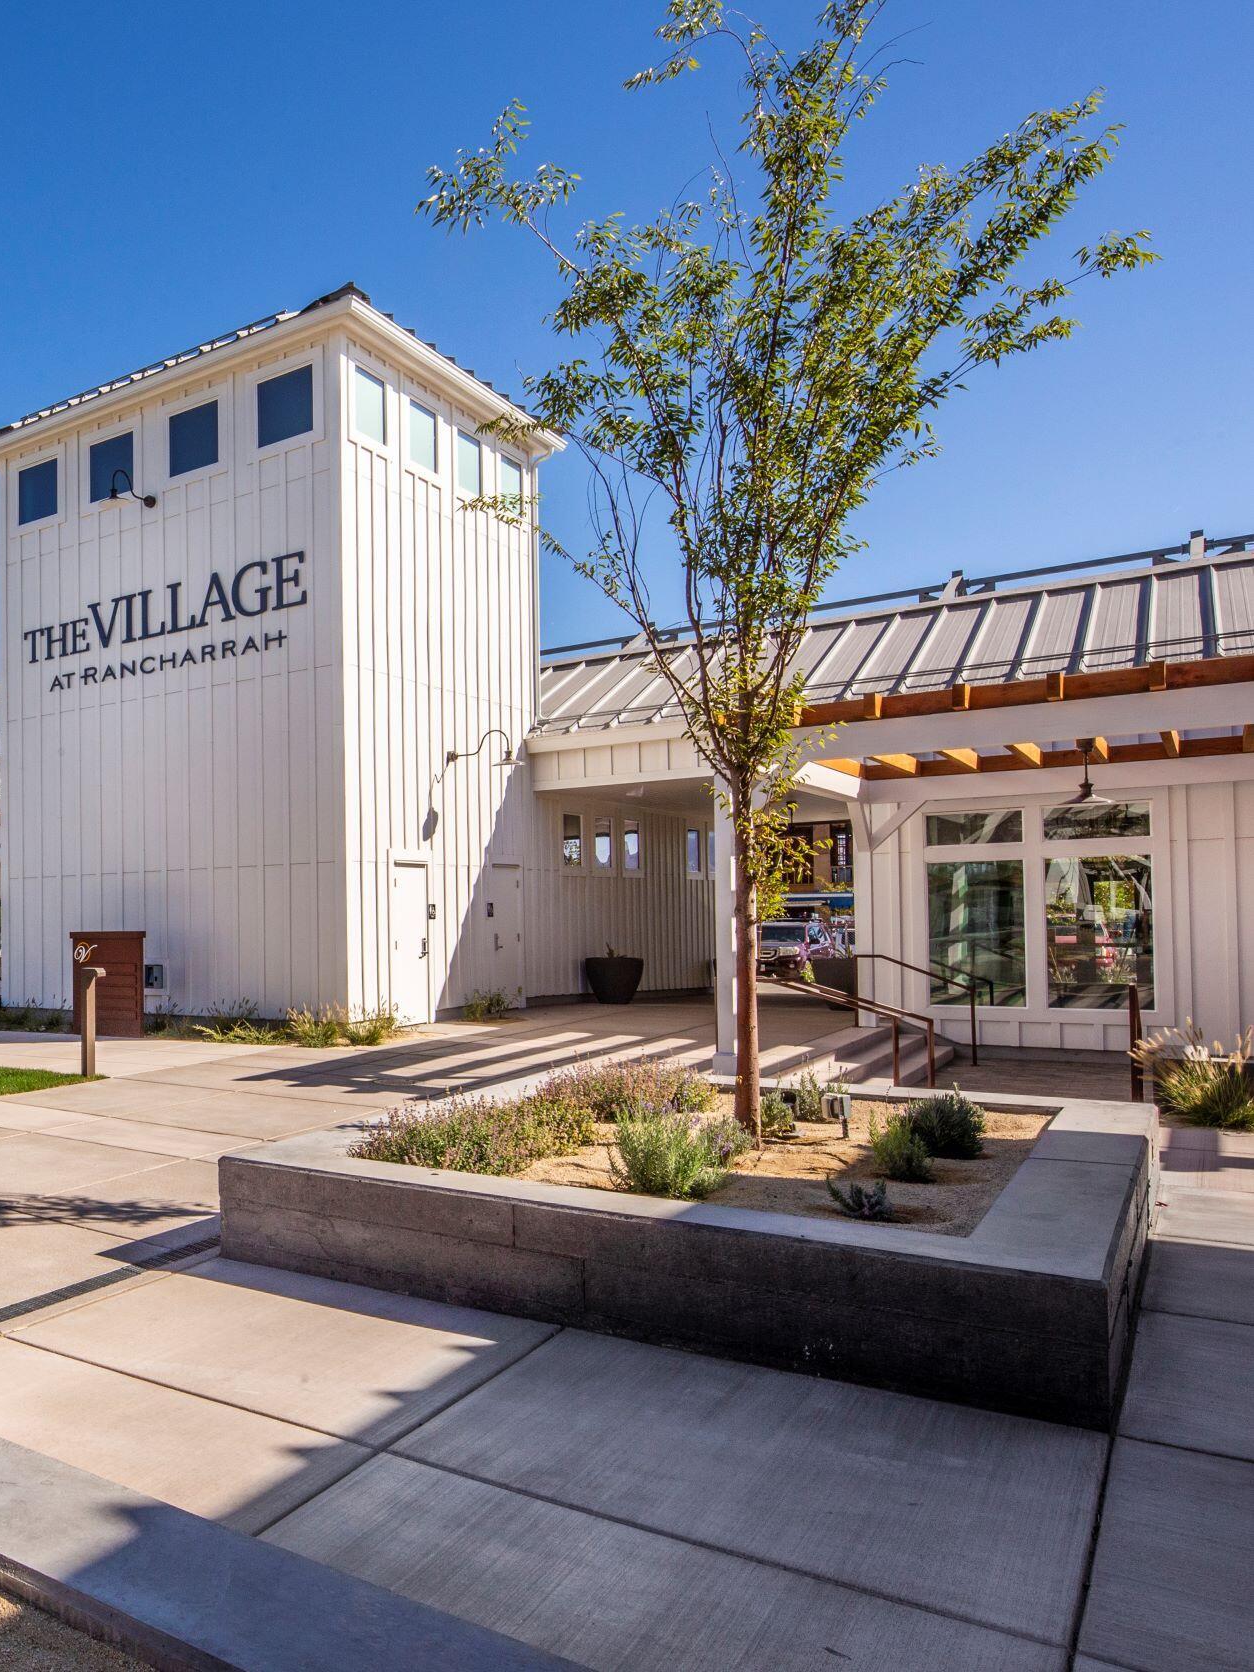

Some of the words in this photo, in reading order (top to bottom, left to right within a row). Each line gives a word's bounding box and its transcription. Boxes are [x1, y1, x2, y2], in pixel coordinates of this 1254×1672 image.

[23, 618, 90, 664] THE
[87, 551, 308, 649] VILLAGE
[49, 672, 76, 692] AT
[80, 630, 288, 686] RANCHARRAH
